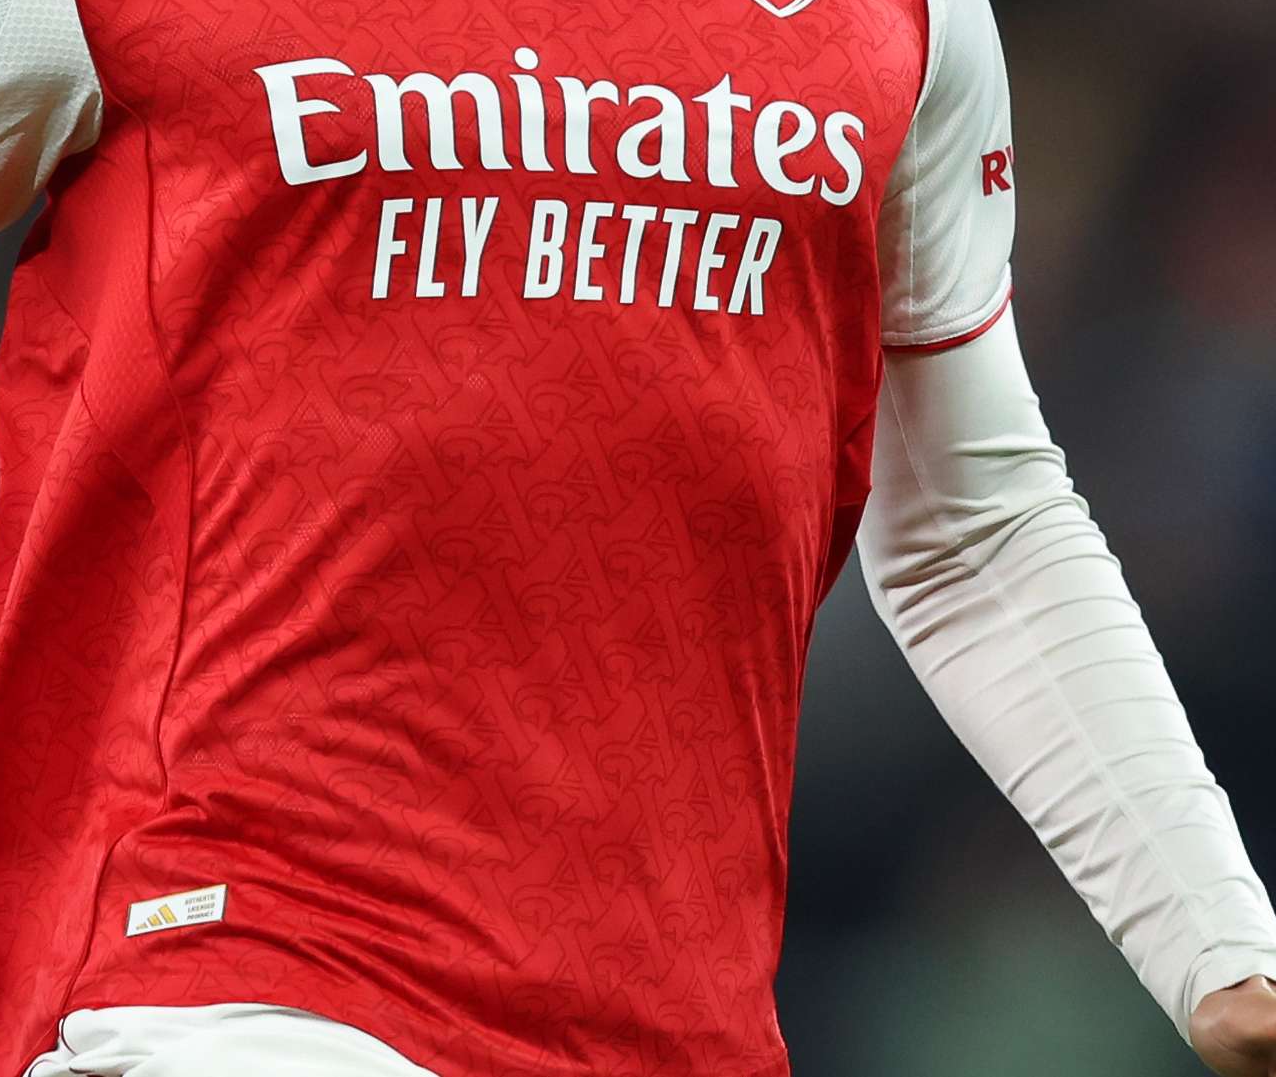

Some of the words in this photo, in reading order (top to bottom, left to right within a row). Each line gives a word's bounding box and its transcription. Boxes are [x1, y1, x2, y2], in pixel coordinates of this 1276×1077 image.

[253, 46, 864, 206] Emirates
[372, 196, 499, 299] FLY
[523, 199, 782, 316] BETTER
